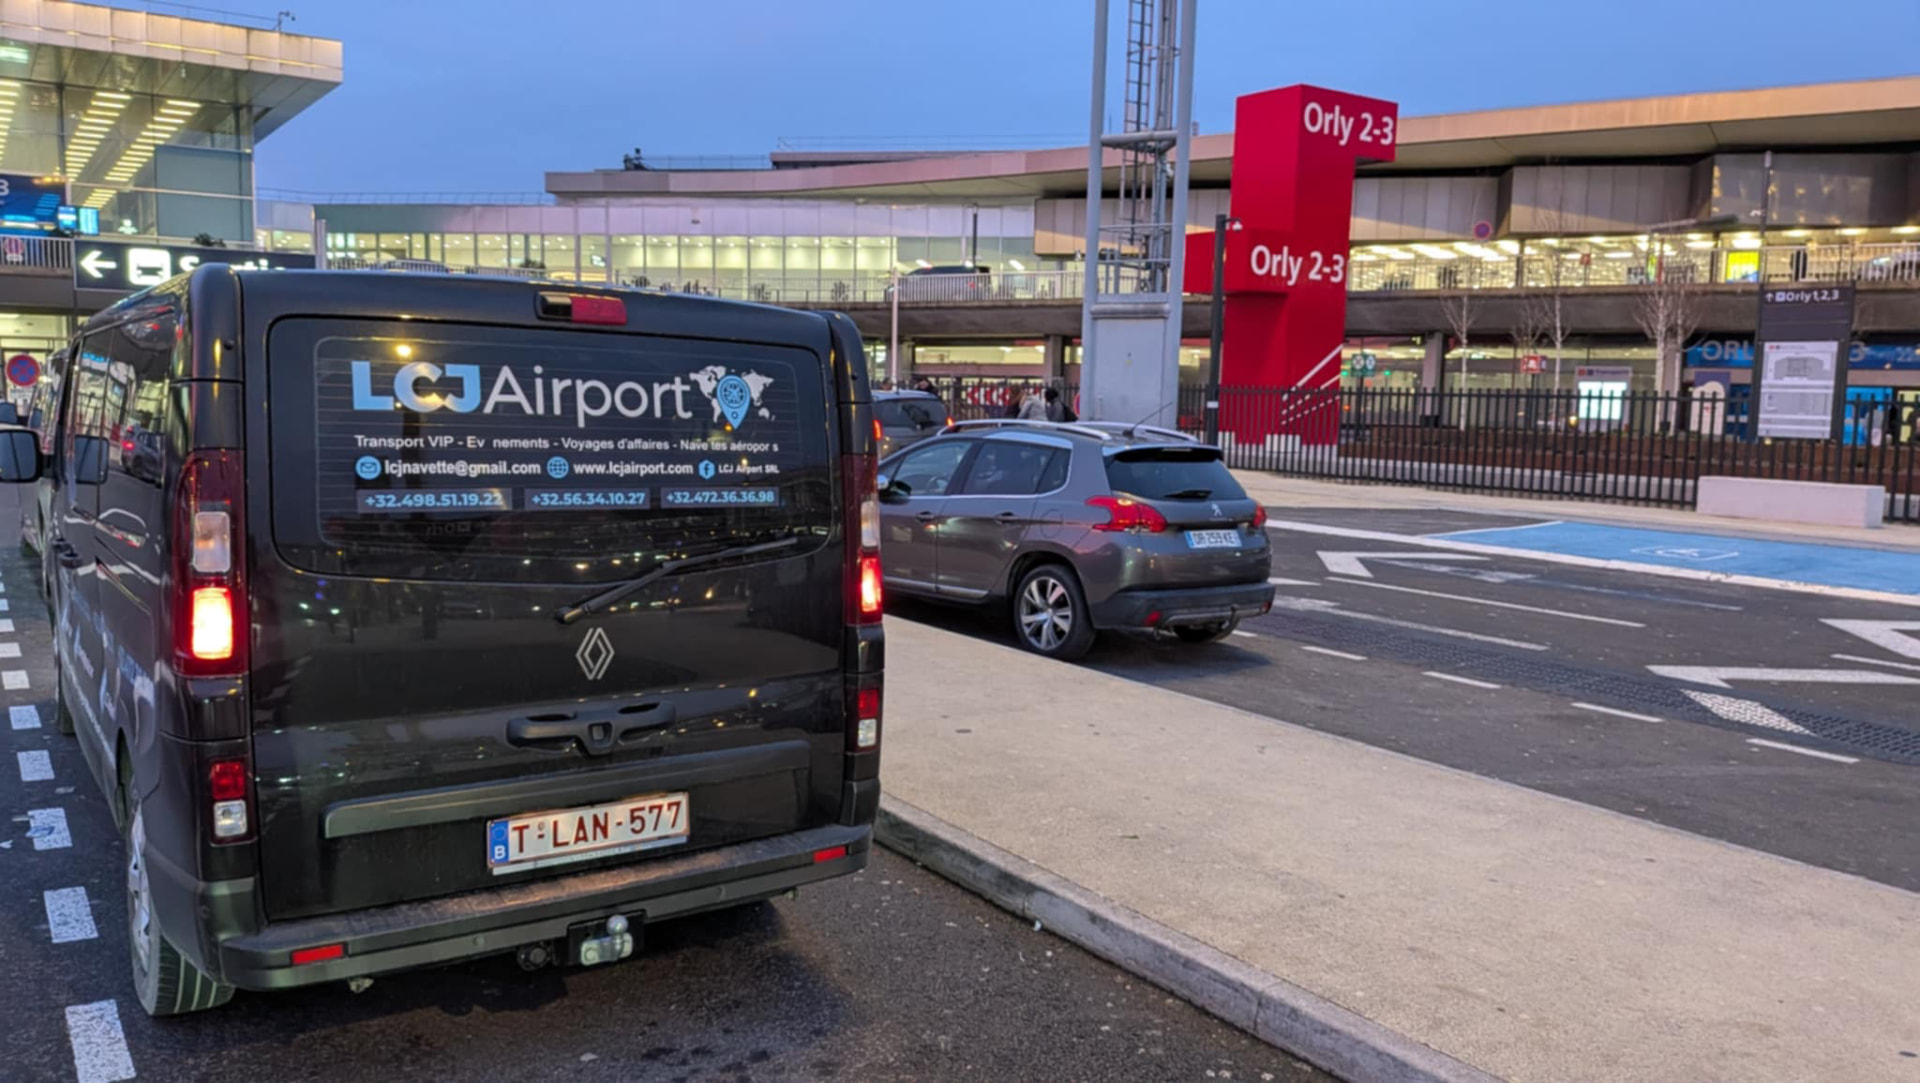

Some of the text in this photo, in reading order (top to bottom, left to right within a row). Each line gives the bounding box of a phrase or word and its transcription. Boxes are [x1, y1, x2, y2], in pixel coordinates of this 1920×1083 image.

[1304, 102, 1394, 146] Orly 2-3
[1251, 245, 1345, 286] Orly 2-3
[1786, 289, 1839, 303] Orly 1,2,3
[1702, 340, 1754, 361] ORL
[351, 361, 693, 428] LCJ Airport
[354, 435, 425, 450] Transport
[427, 435, 454, 448] VIP
[561, 437, 615, 452] Voyages
[617, 438, 670, 450] d'affaires
[384, 460, 541, 478] lcjnavette@gmail.com
[573, 461, 694, 477] www.lcjairport.com
[718, 464, 780, 474] LCJ Airport SRL
[365, 493, 504, 508] +32.498.51.19.22
[532, 492, 646, 506] +32.56.34.10.27
[666, 491, 774, 504] +32.472.36.36.98
[494, 845, 506, 859] B
